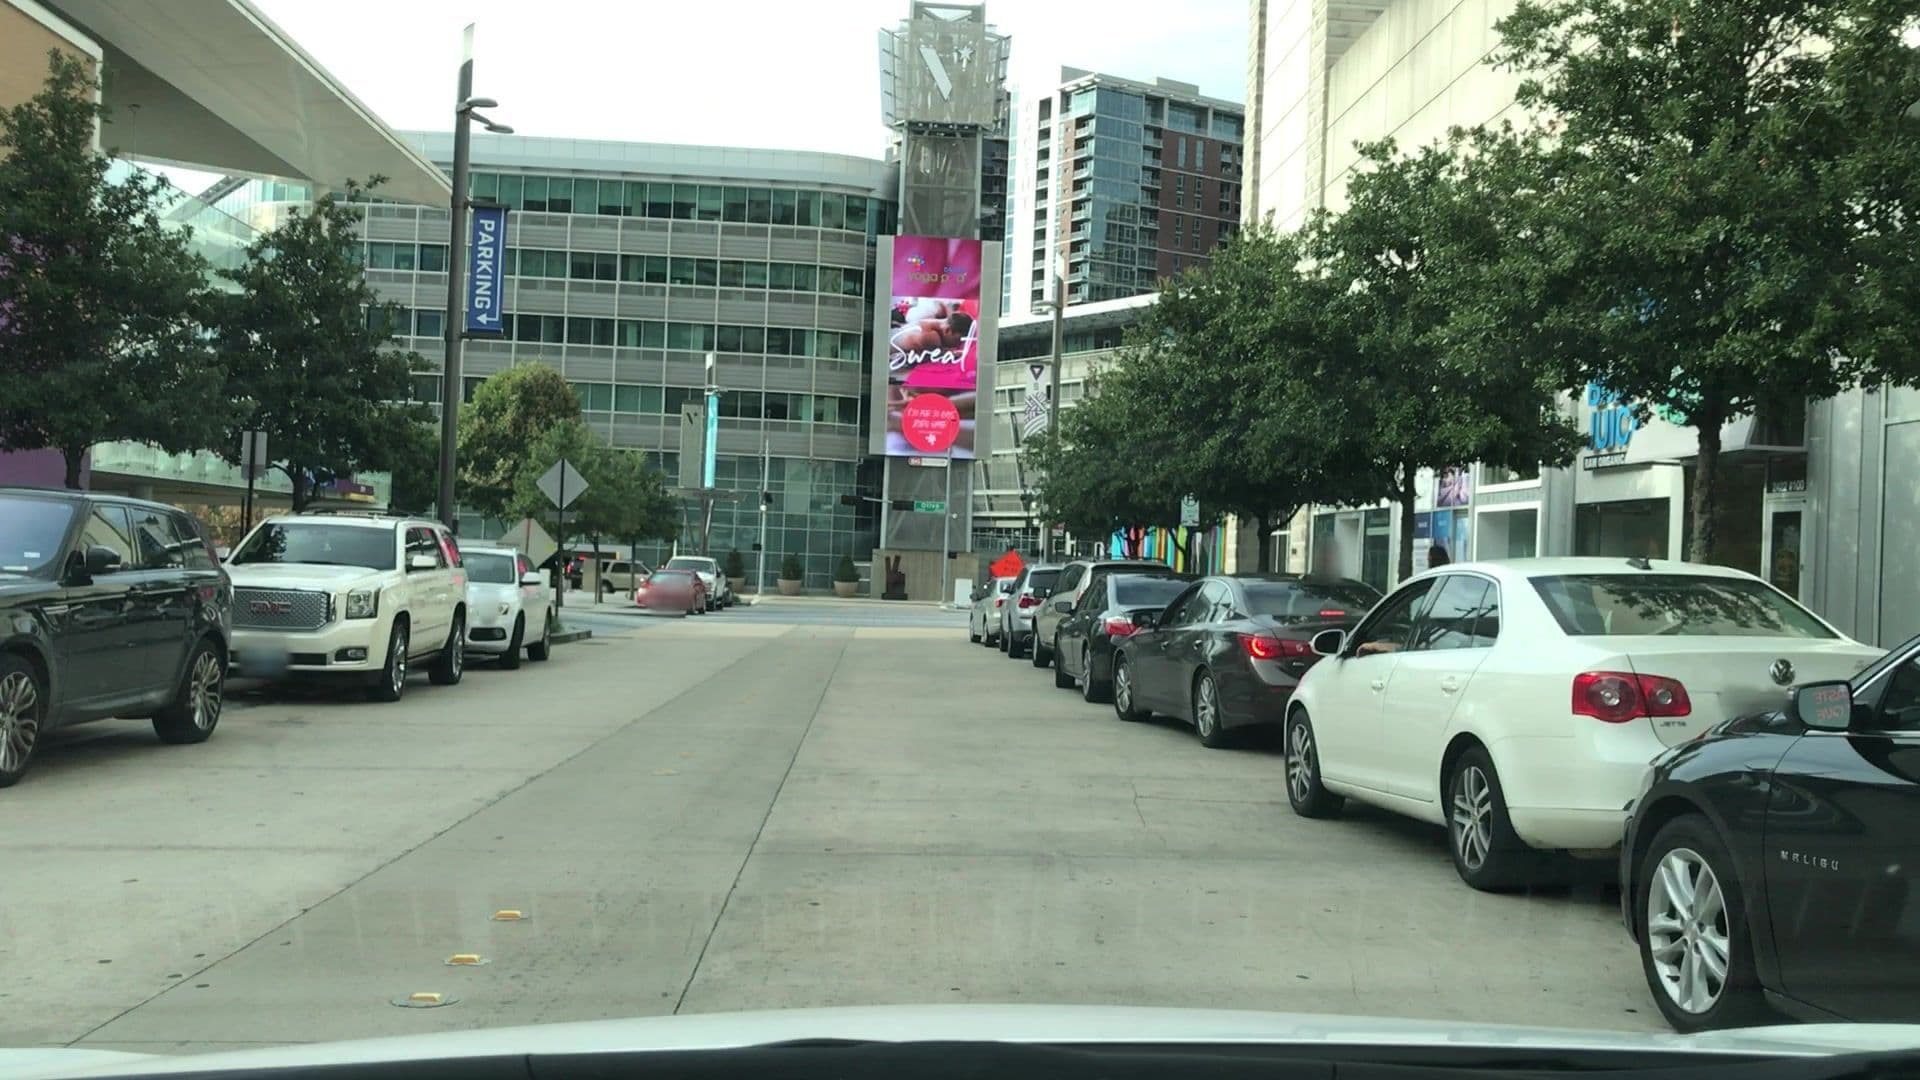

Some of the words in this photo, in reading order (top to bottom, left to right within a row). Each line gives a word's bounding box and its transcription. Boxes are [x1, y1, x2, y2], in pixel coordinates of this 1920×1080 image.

[474, 219, 495, 310] PARKING
[889, 319, 978, 372] Sweat
[1780, 850, 1839, 871] MALIBU
